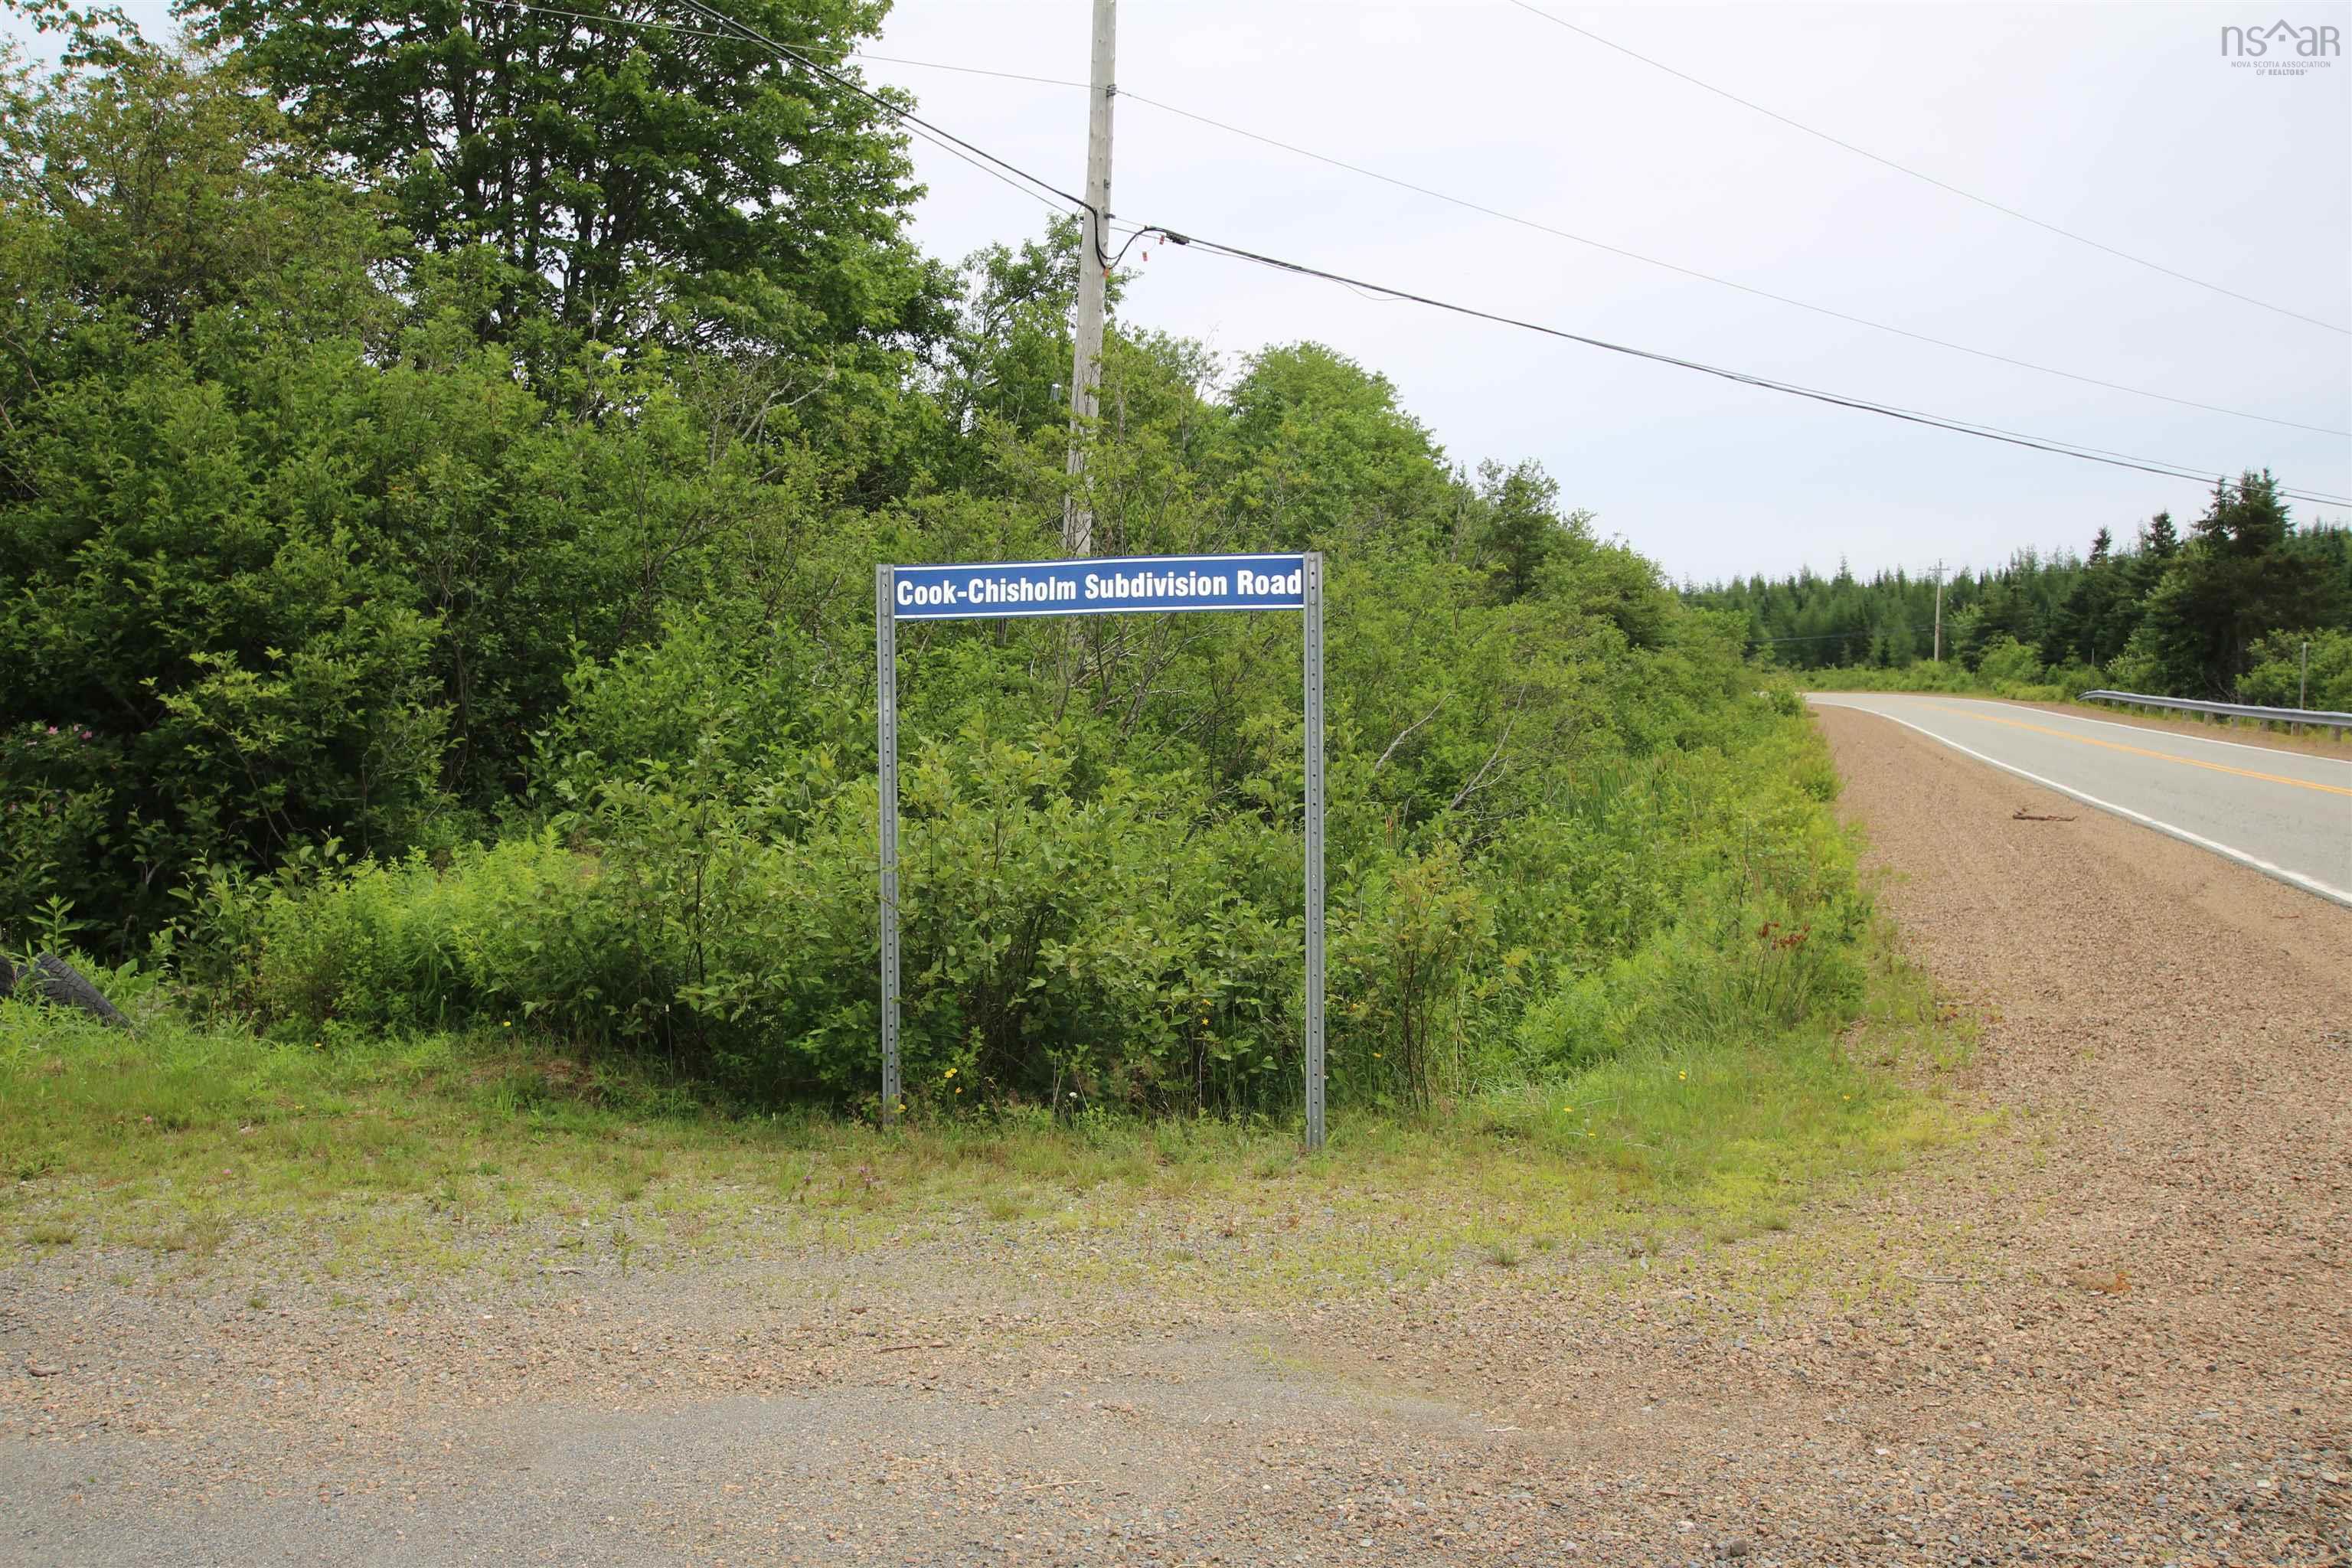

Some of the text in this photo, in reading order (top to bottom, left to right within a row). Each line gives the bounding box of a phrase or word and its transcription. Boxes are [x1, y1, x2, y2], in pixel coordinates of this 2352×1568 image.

[897, 569, 1302, 606] Cook-Chisholm Subdivision Road
